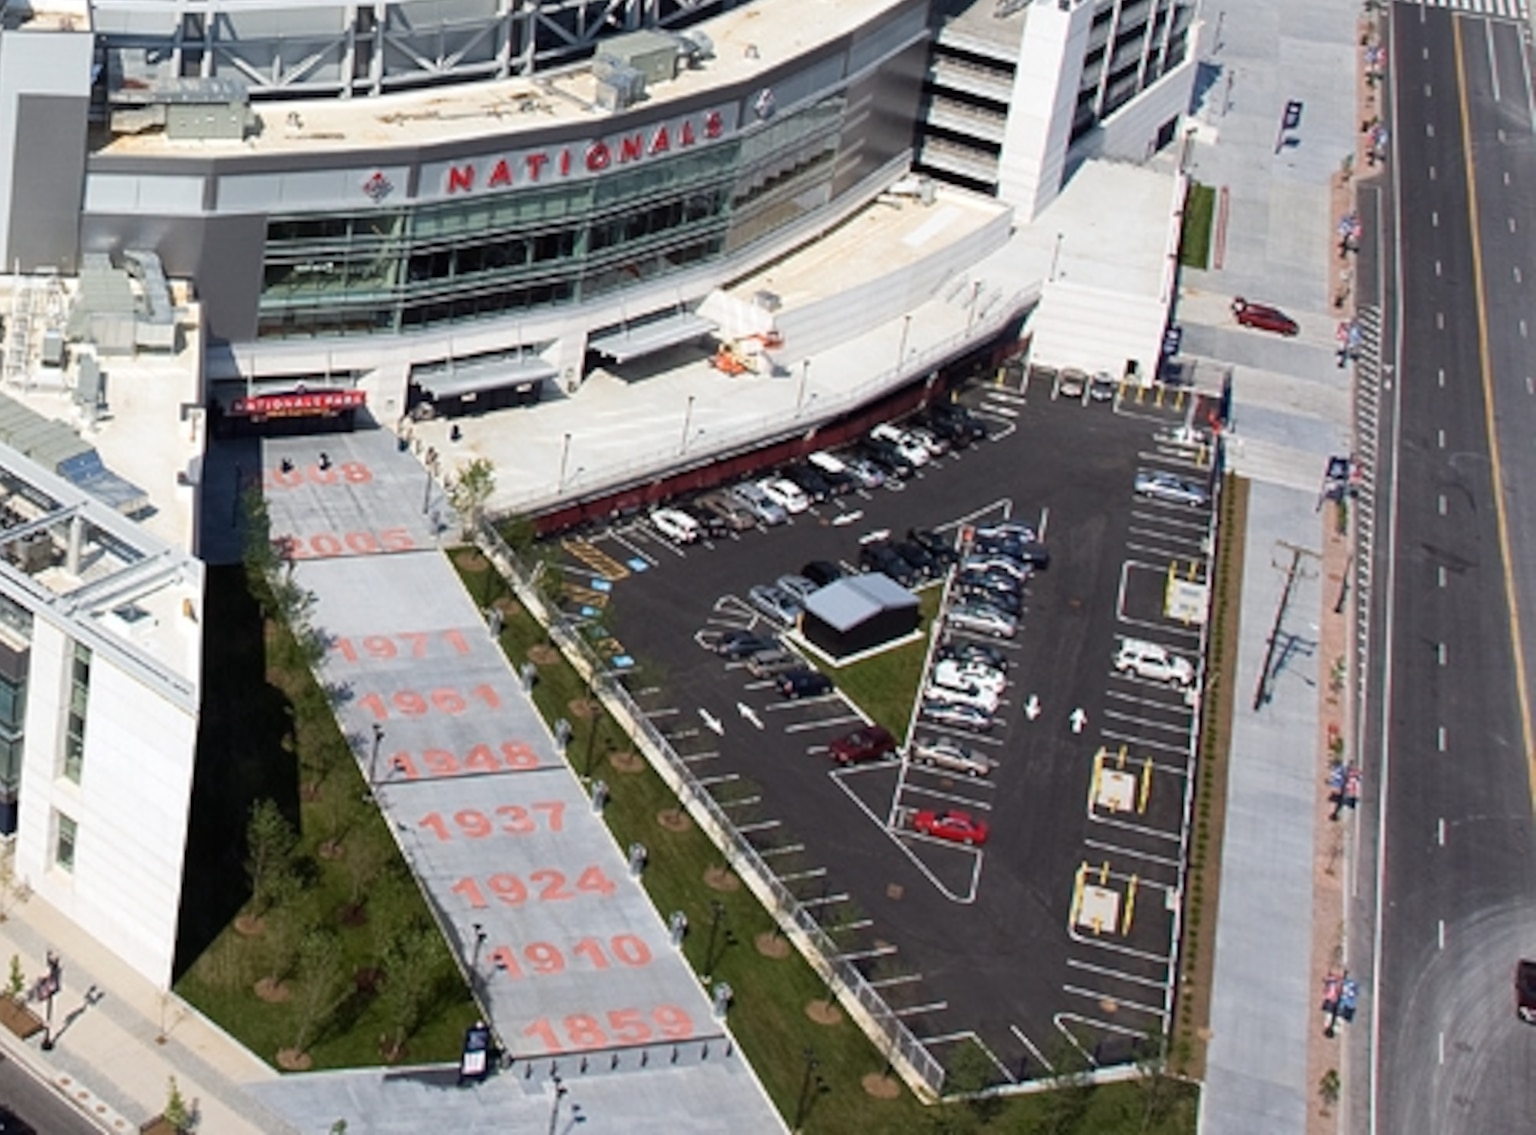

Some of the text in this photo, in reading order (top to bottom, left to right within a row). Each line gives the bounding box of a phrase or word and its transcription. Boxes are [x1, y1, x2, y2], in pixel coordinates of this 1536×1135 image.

[445, 111, 725, 194] NATIONALS
[330, 627, 471, 663] 1971
[388, 740, 540, 780] 1948
[417, 801, 568, 842] 1937
[451, 864, 617, 909] 1924
[486, 933, 653, 980] 1910
[523, 1005, 695, 1053] 1859
